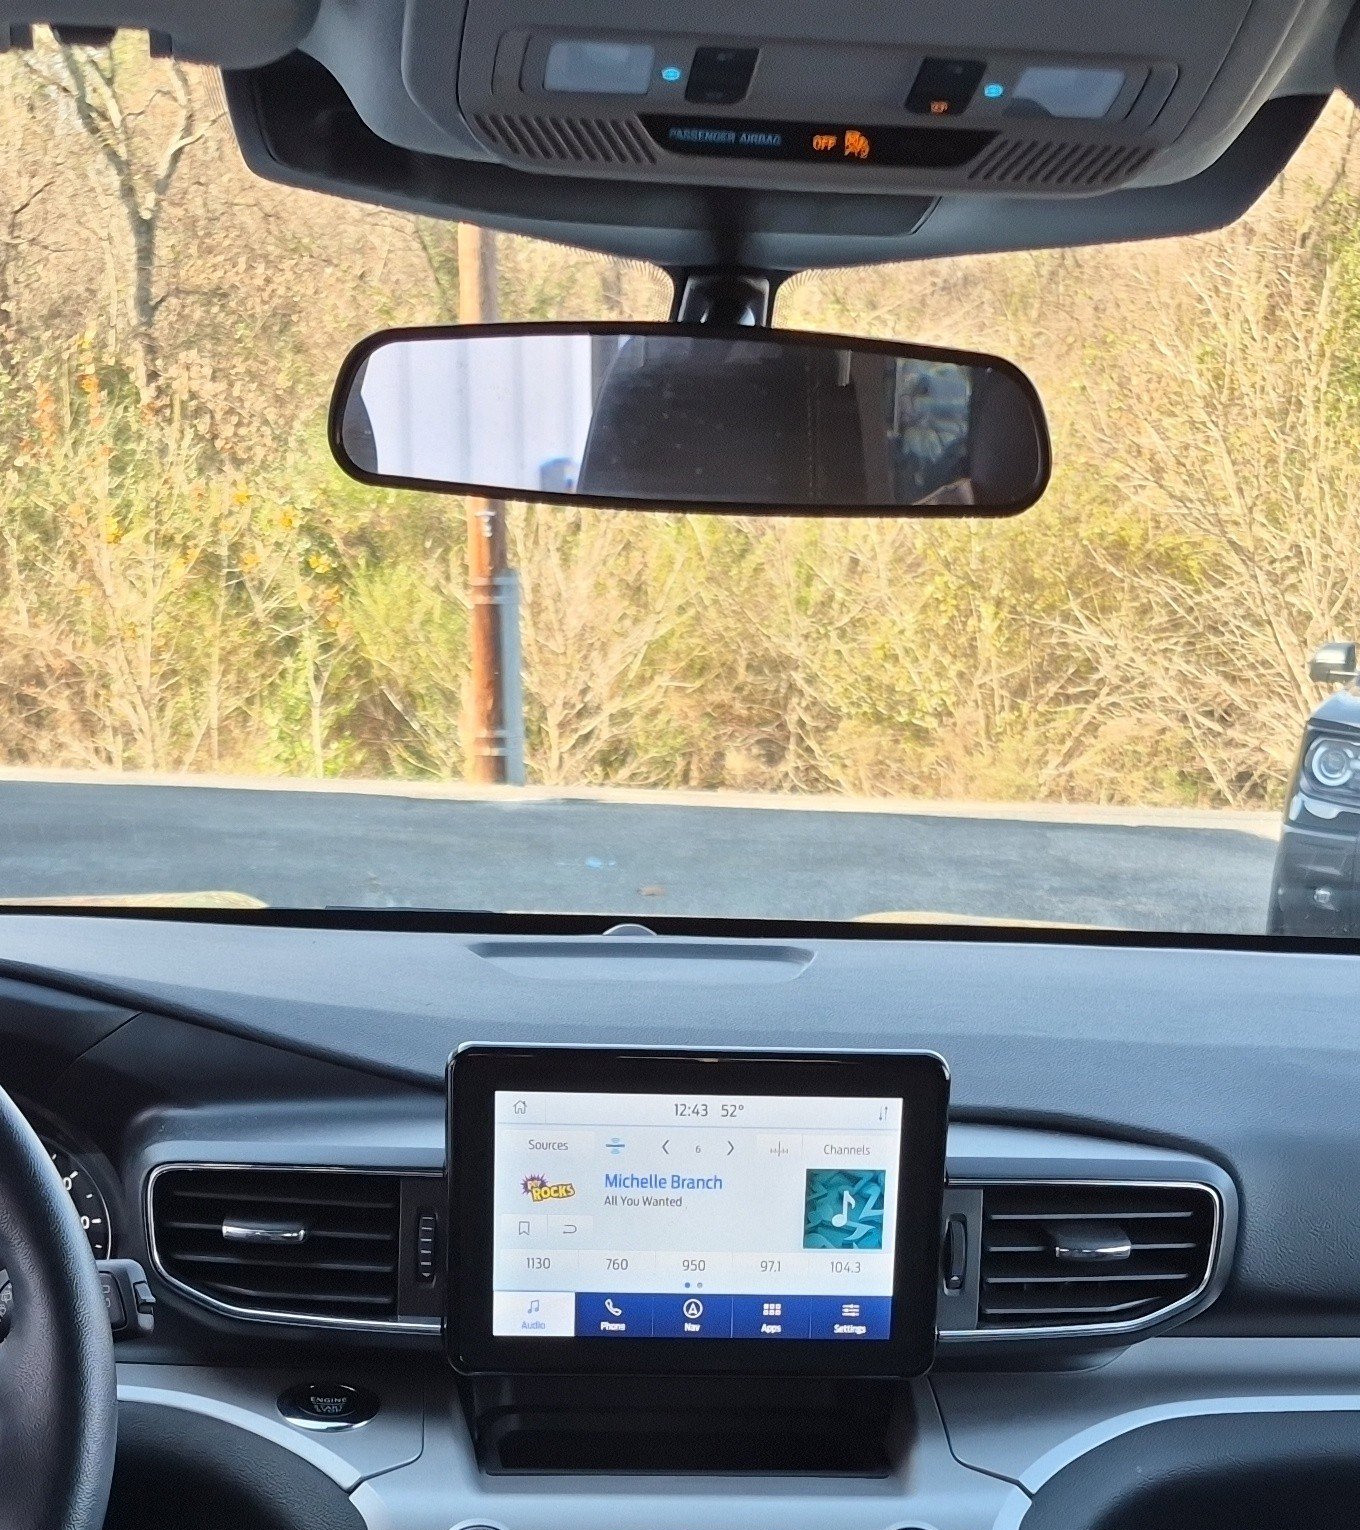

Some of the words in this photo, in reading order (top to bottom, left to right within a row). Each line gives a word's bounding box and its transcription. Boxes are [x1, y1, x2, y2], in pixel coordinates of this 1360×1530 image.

[813, 134, 837, 150] OFF
[674, 1103, 708, 1117] 12:43
[721, 1104, 744, 1117] 52°
[528, 1139, 569, 1151] Sources
[695, 1145, 701, 1154] 6
[823, 1144, 871, 1156] Channels
[605, 1173, 667, 1189] Michelle
[671, 1174, 723, 1190] Branch
[531, 1183, 575, 1202] ROCKS
[604, 1195, 618, 1206] All
[620, 1196, 640, 1207] You
[642, 1196, 683, 1207] Wanted
[526, 1257, 551, 1270] 1130
[606, 1258, 629, 1271] 760
[682, 1259, 706, 1272] 950
[760, 1260, 781, 1273] 97.1
[830, 1261, 861, 1274] 104.3
[521, 1321, 546, 1330] Audio
[600, 1321, 626, 1332] Phone
[684, 1323, 701, 1332] Nav
[760, 1323, 782, 1334] Apps
[833, 1324, 867, 1335] Settings
